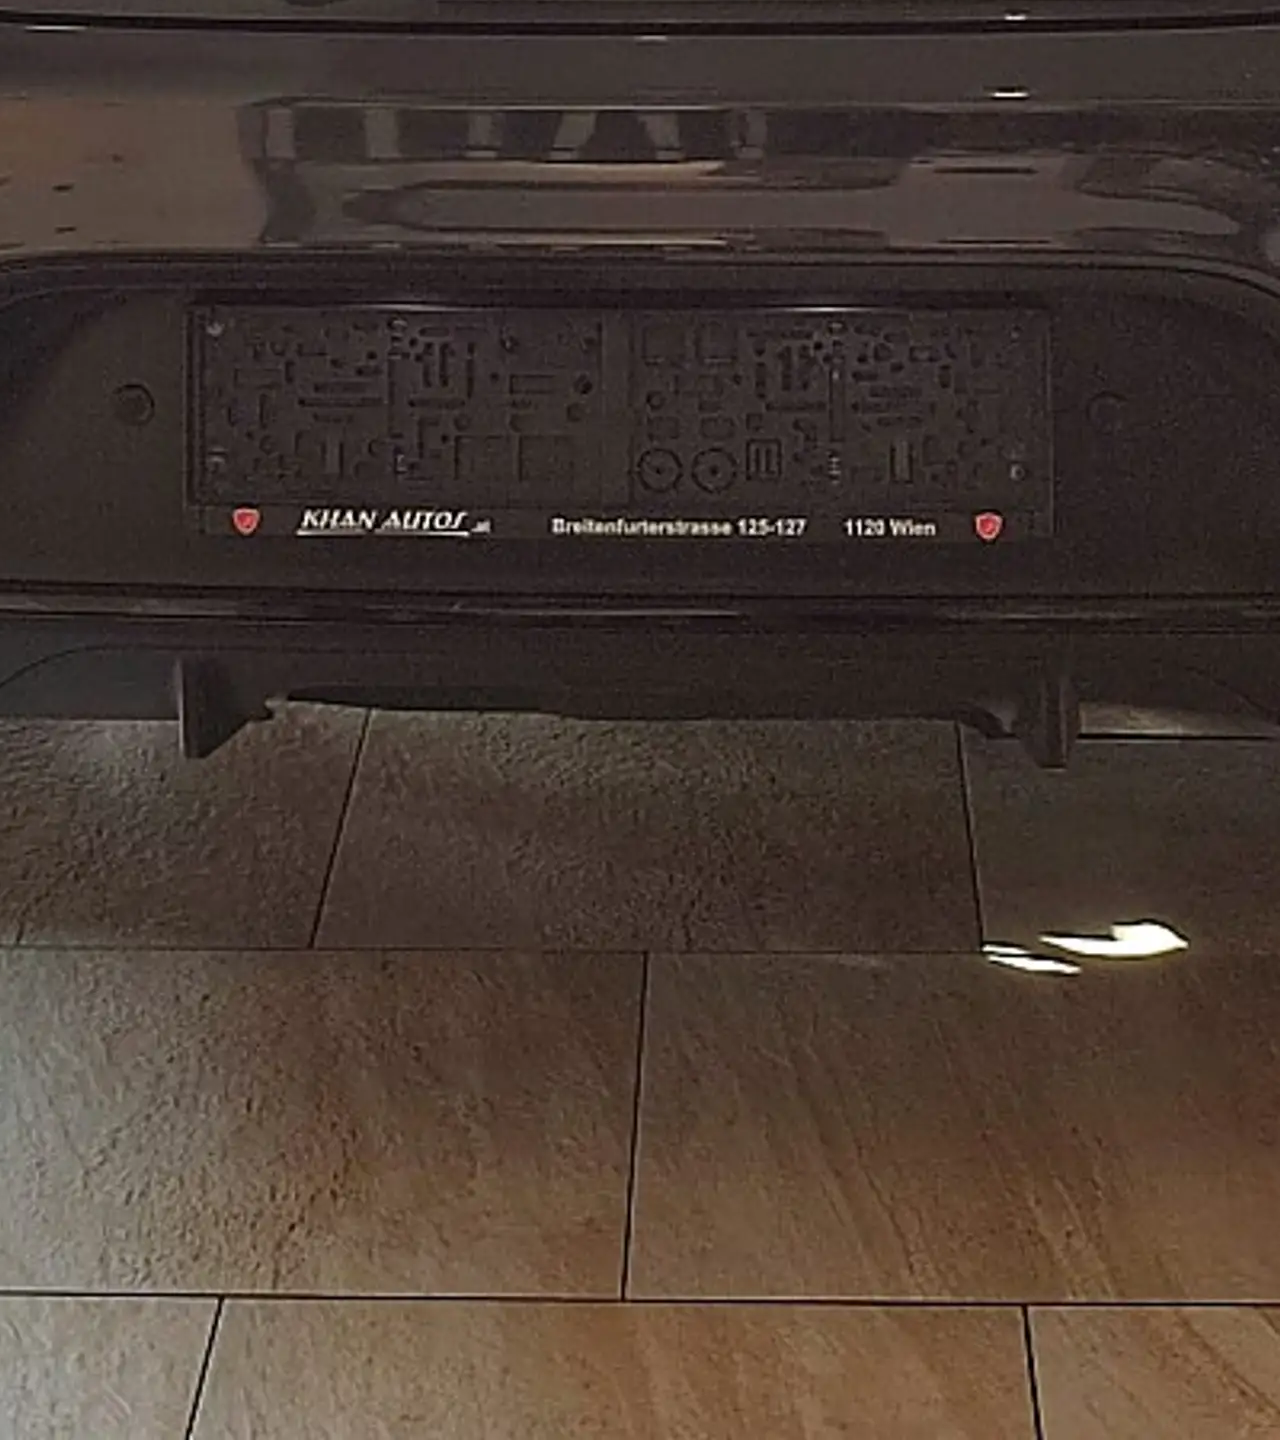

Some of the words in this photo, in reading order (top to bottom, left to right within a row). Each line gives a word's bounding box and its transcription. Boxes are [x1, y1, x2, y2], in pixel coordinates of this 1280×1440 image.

[301, 508, 377, 530] KHAN
[380, 510, 469, 531] AUTOS
[844, 518, 886, 537] 1120
[890, 518, 937, 537] Wien
